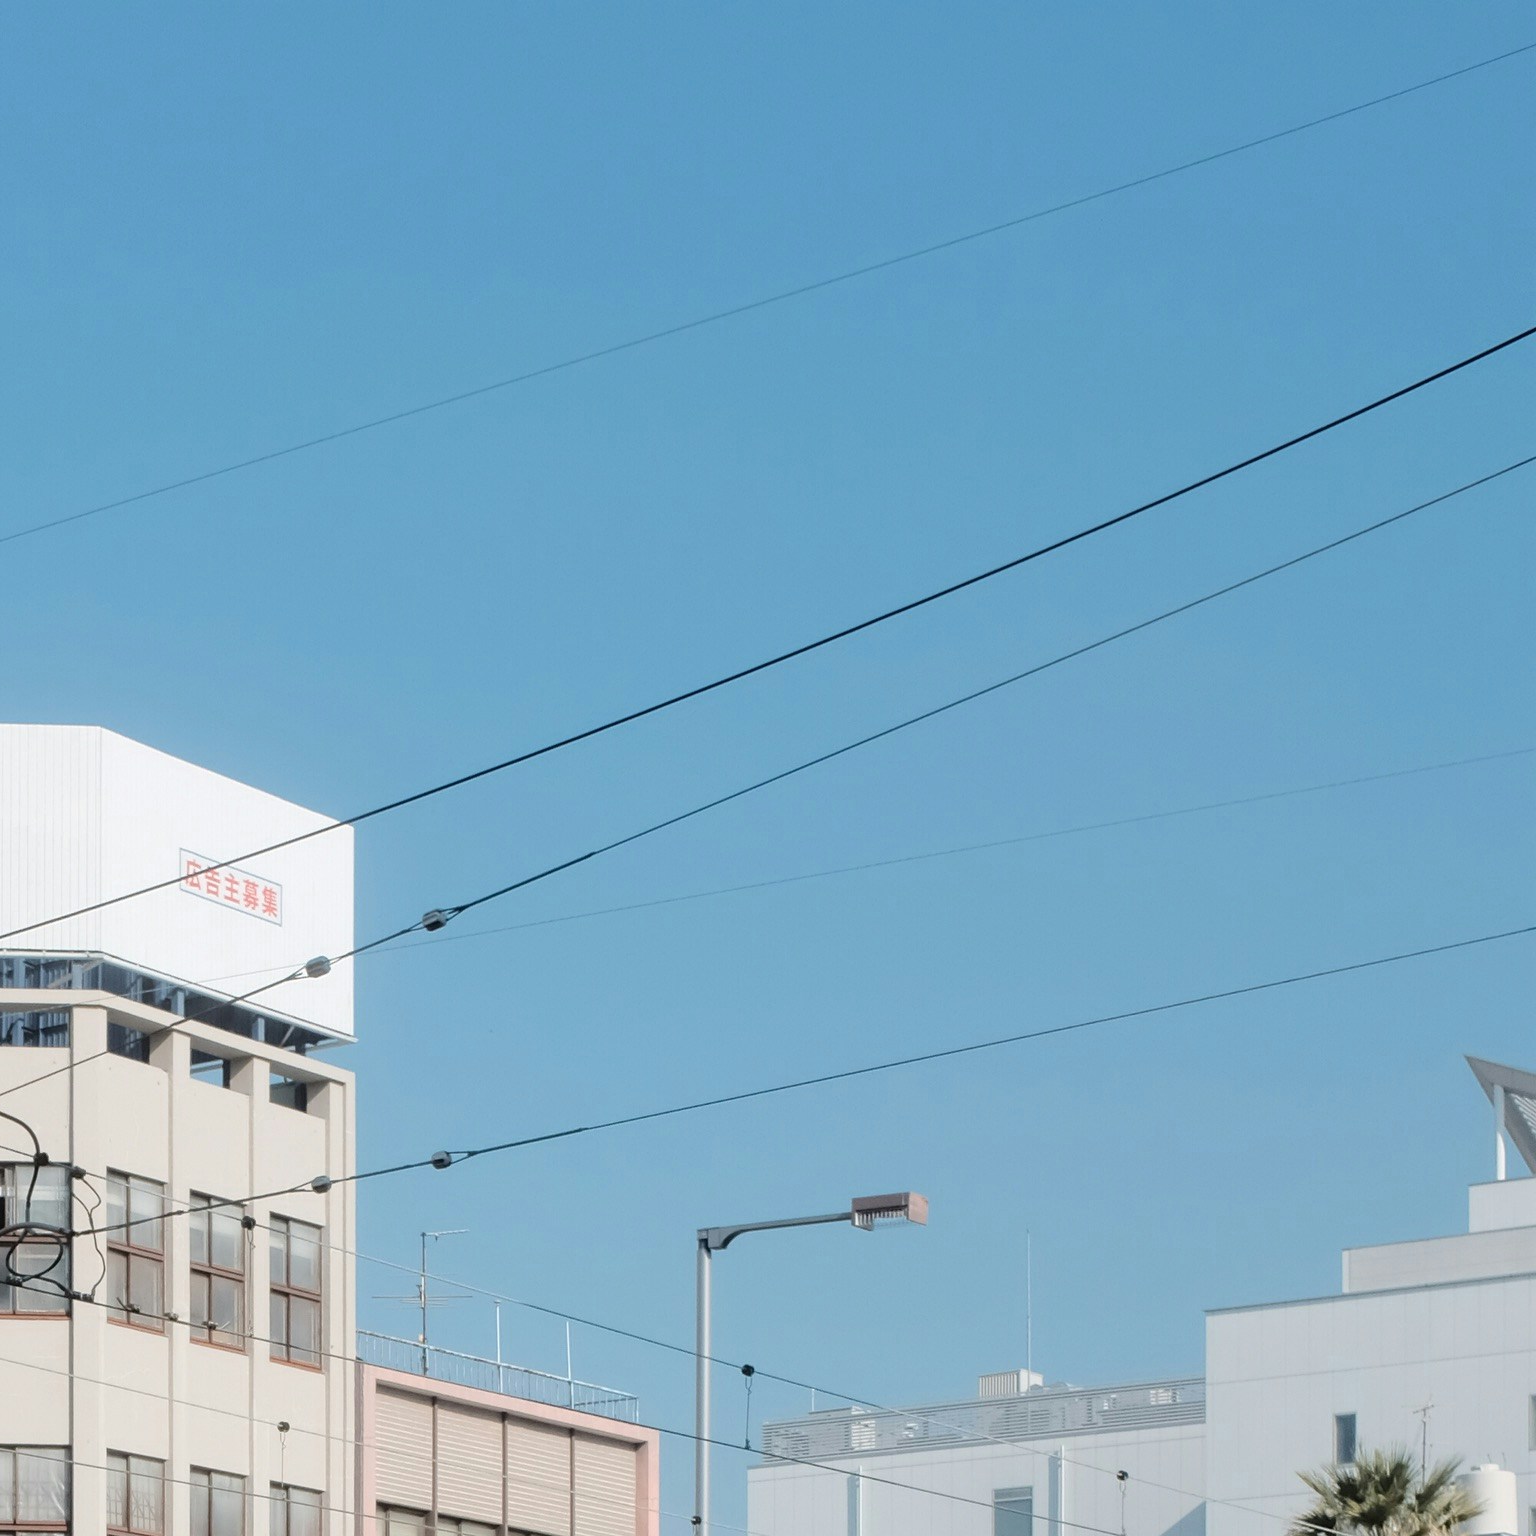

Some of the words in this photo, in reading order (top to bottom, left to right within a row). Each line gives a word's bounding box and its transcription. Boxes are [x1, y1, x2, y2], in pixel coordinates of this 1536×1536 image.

[185, 859, 278, 918] 広告主募集
